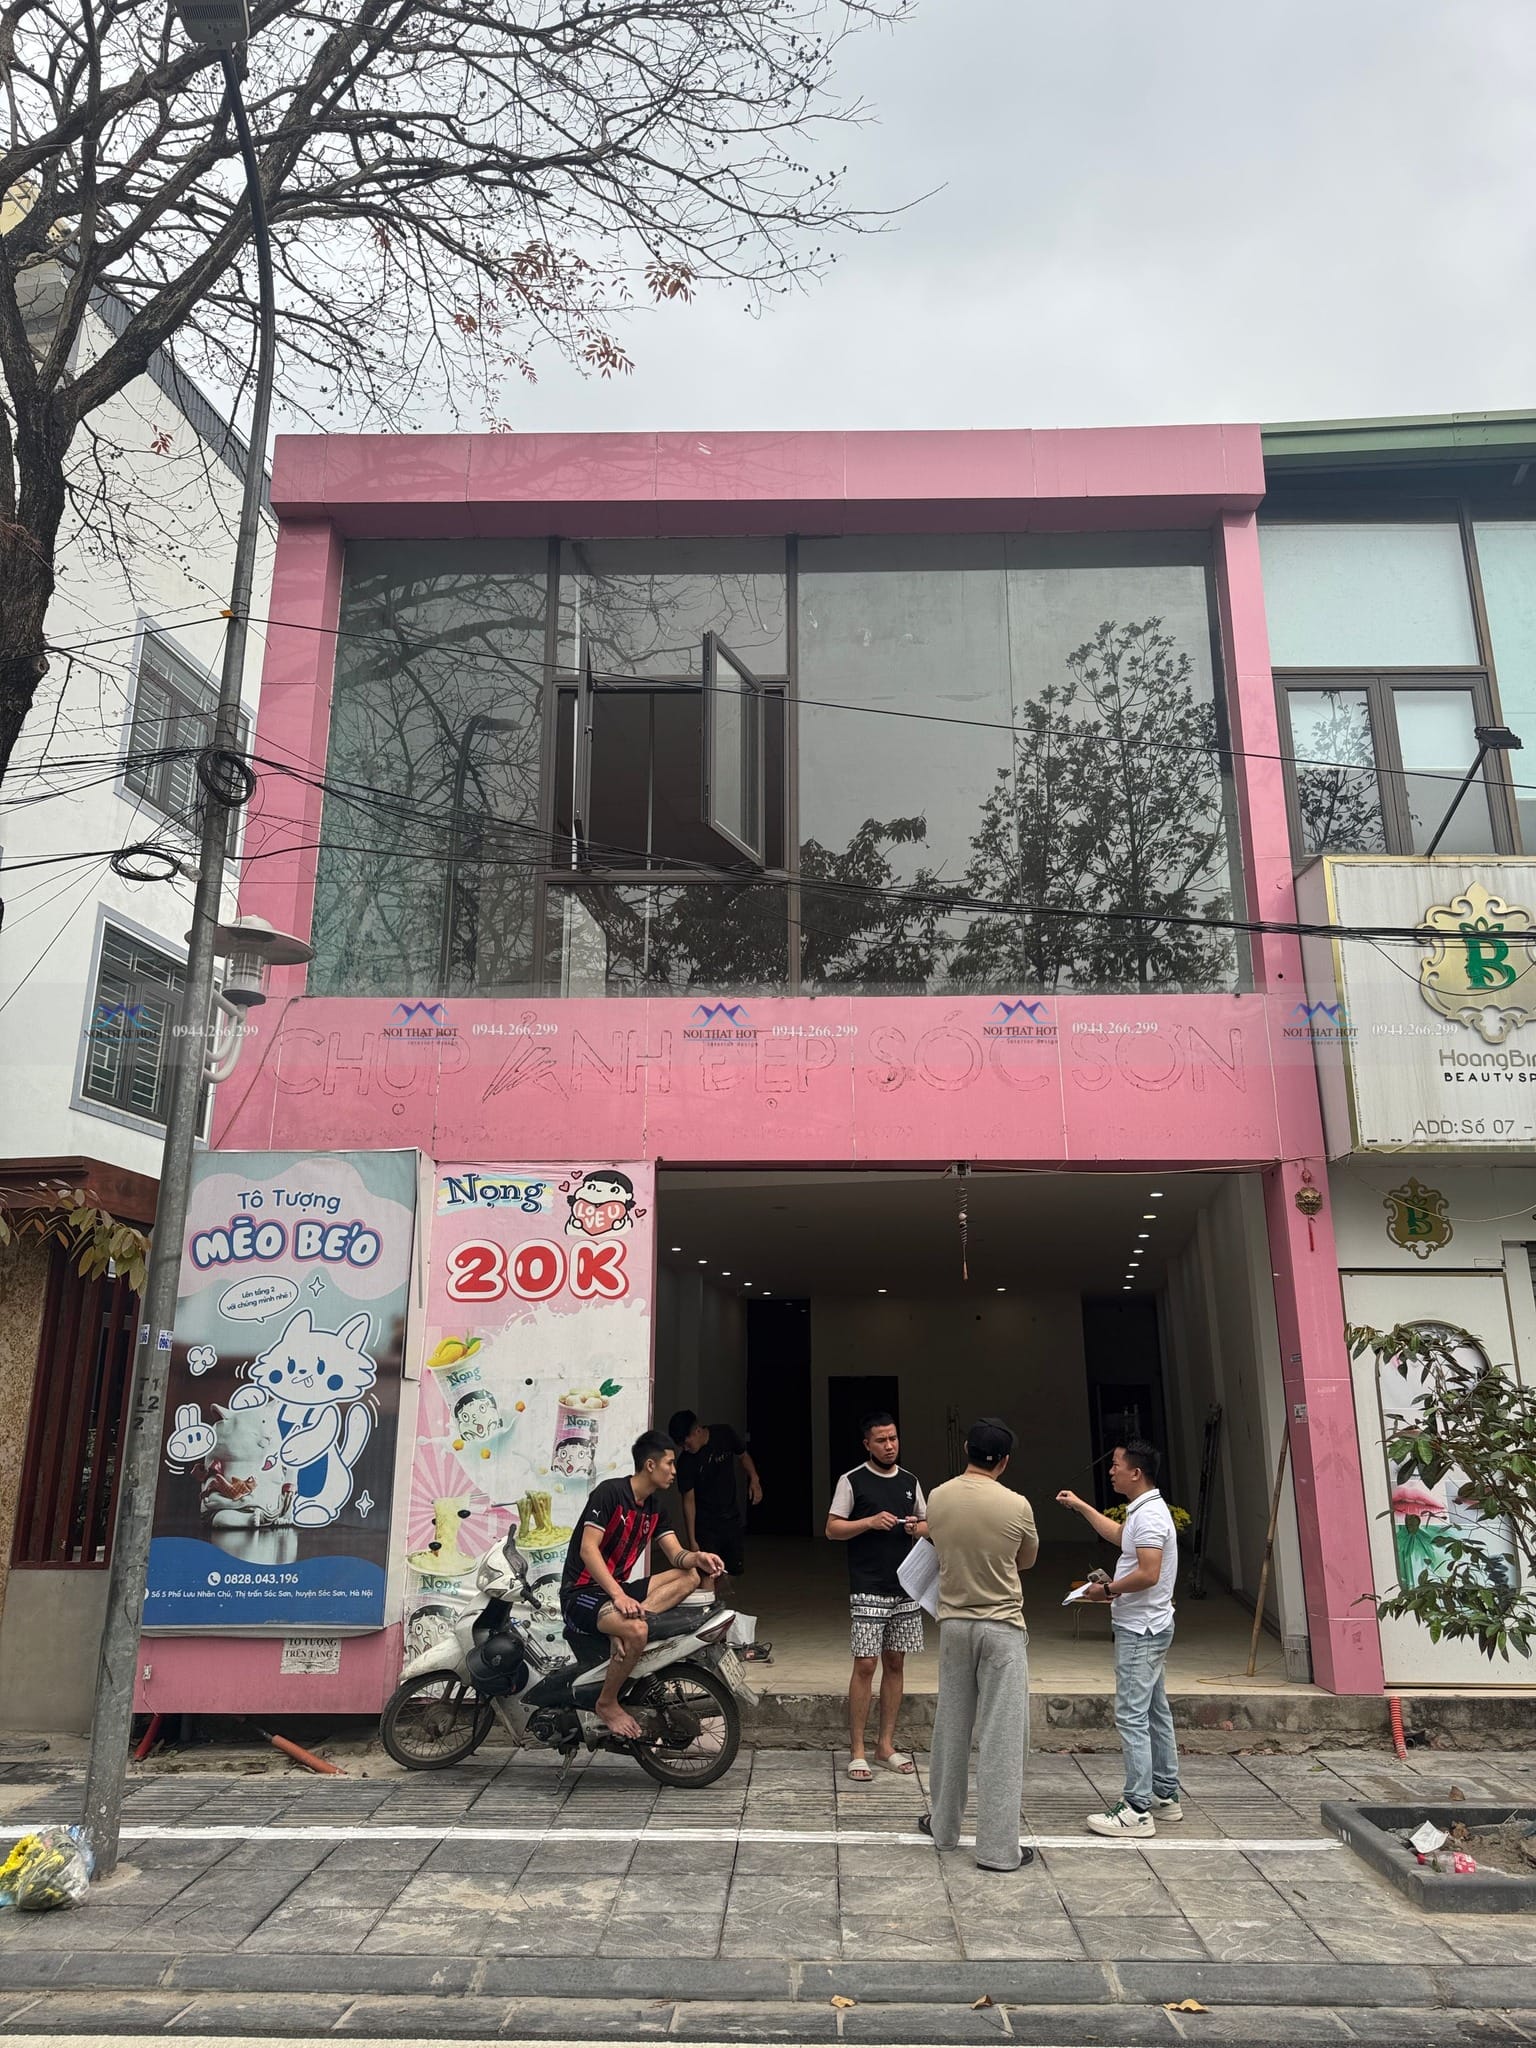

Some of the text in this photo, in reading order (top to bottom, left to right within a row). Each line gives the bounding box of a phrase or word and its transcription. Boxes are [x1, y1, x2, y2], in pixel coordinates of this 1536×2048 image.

[1493, 1119, 1515, 1135] 07
[237, 1189, 341, 1214] Tô Tượng
[442, 1173, 546, 1214] Nọng
[447, 1239, 629, 1302] 20K
[224, 1573, 299, 1585] 0828.043.196
